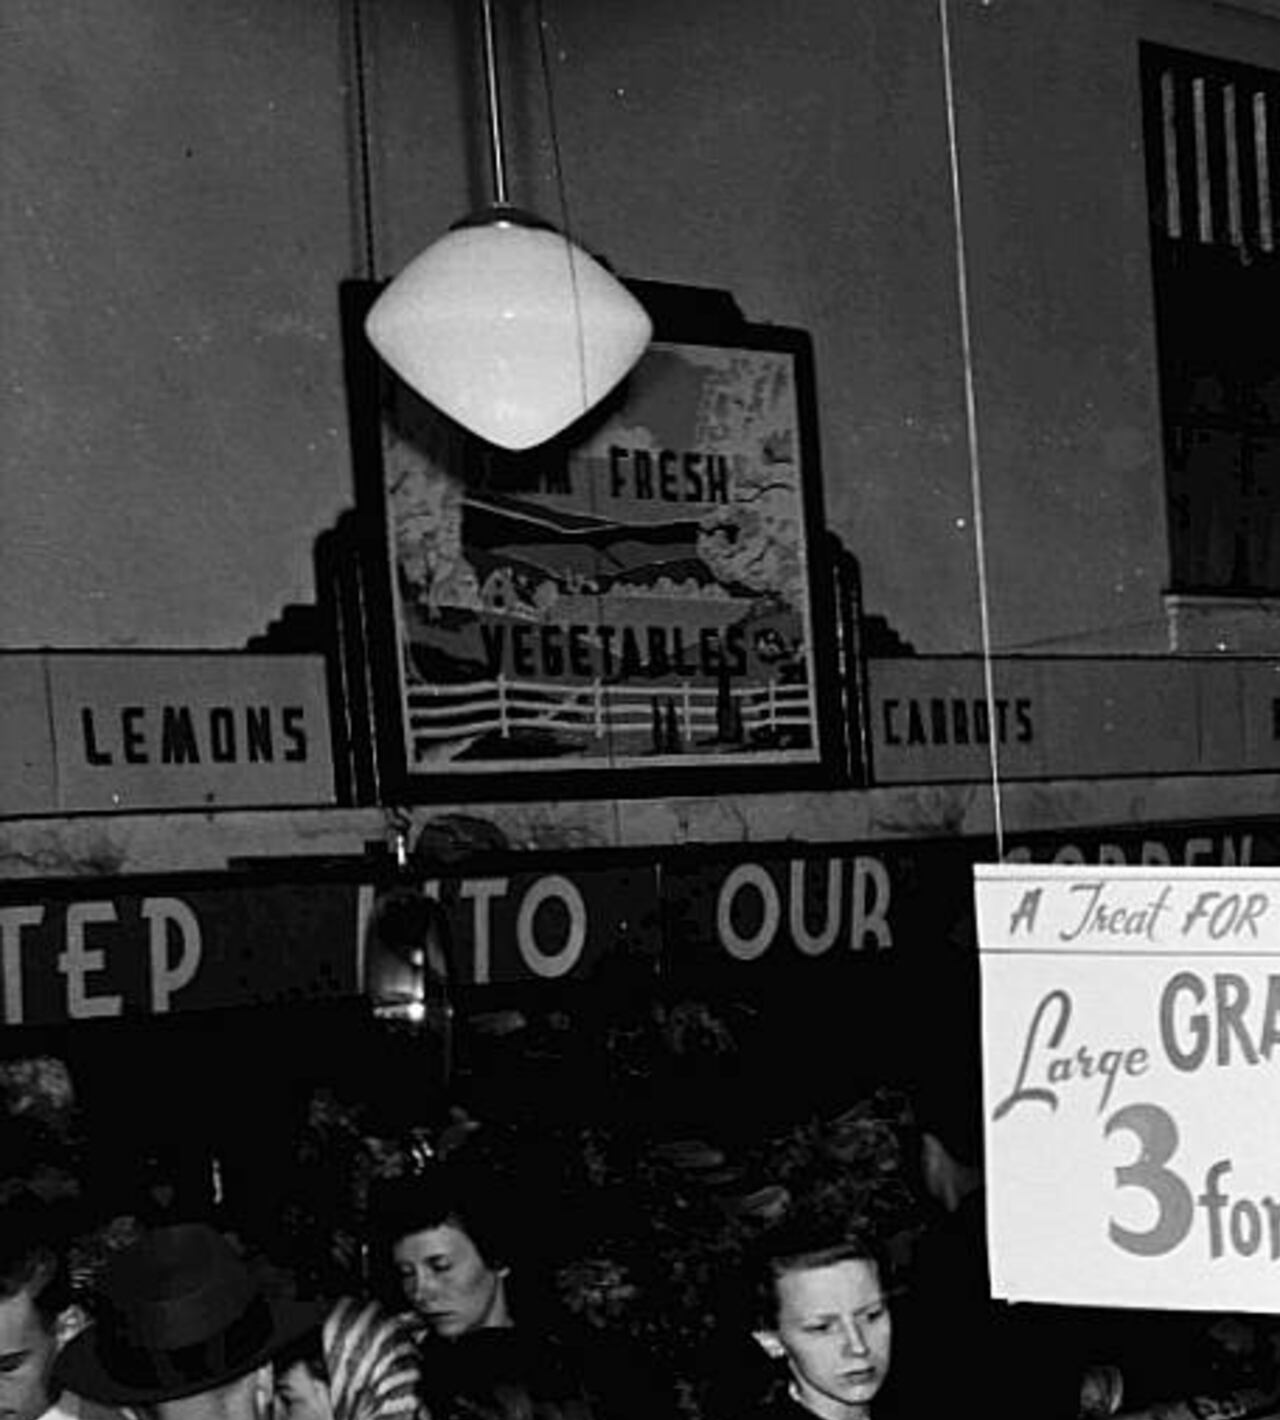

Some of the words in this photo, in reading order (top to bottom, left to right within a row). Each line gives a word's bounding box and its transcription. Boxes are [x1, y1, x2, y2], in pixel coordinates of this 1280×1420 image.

[611, 446, 729, 503] FRESH
[481, 624, 747, 682] VEGETABLES
[81, 706, 308, 766] LEMONS
[882, 698, 1033, 746] CARROTS
[357, 876, 587, 994] ITO
[716, 856, 893, 961] OUR
[1011, 887, 1044, 934] A
[1060, 880, 1169, 942] Treat
[1181, 891, 1262, 935] FOR
[993, 989, 1150, 1122] Large
[1103, 1103, 1195, 1259] 3
